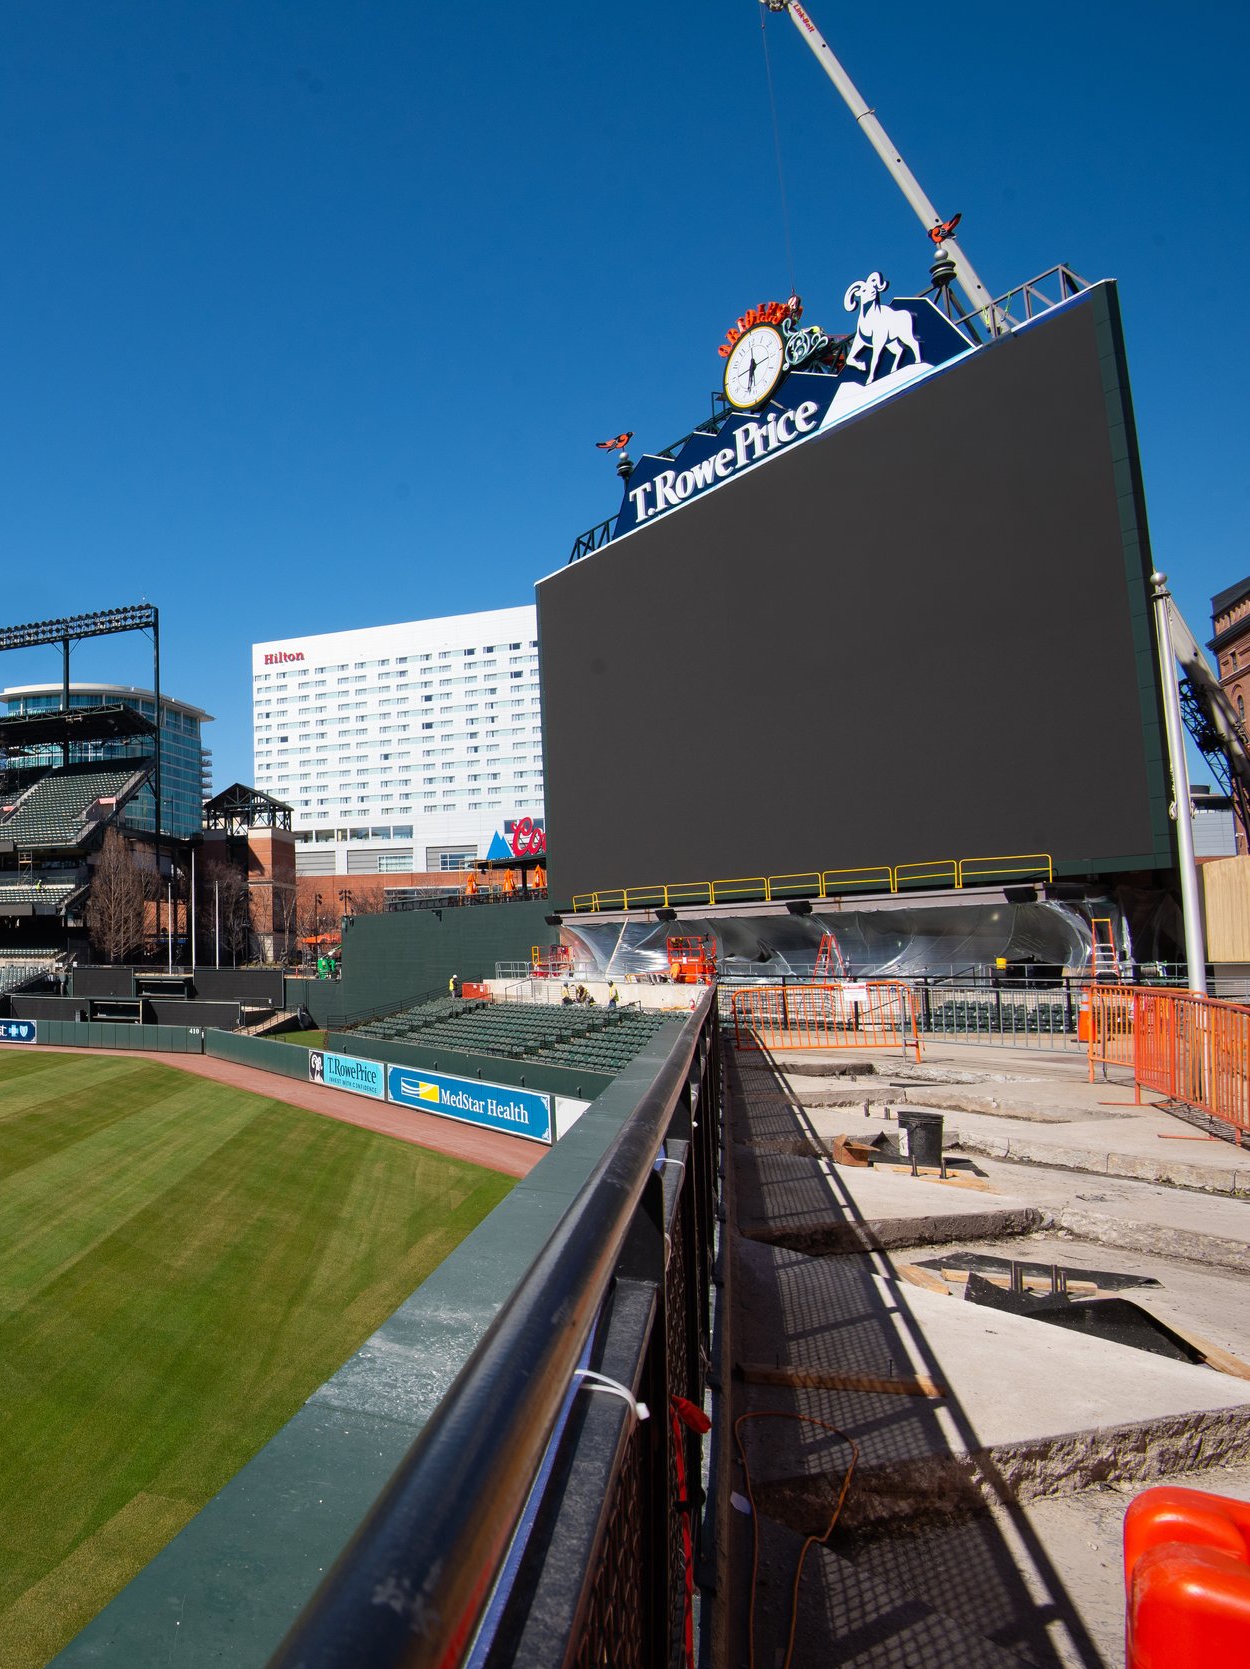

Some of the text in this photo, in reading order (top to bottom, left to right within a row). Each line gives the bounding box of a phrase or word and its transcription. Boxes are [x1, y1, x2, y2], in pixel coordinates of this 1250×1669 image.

[264, 651, 306, 665] Hilton
[510, 816, 547, 857] Co
[440, 1088, 530, 1125] MedStar Health
